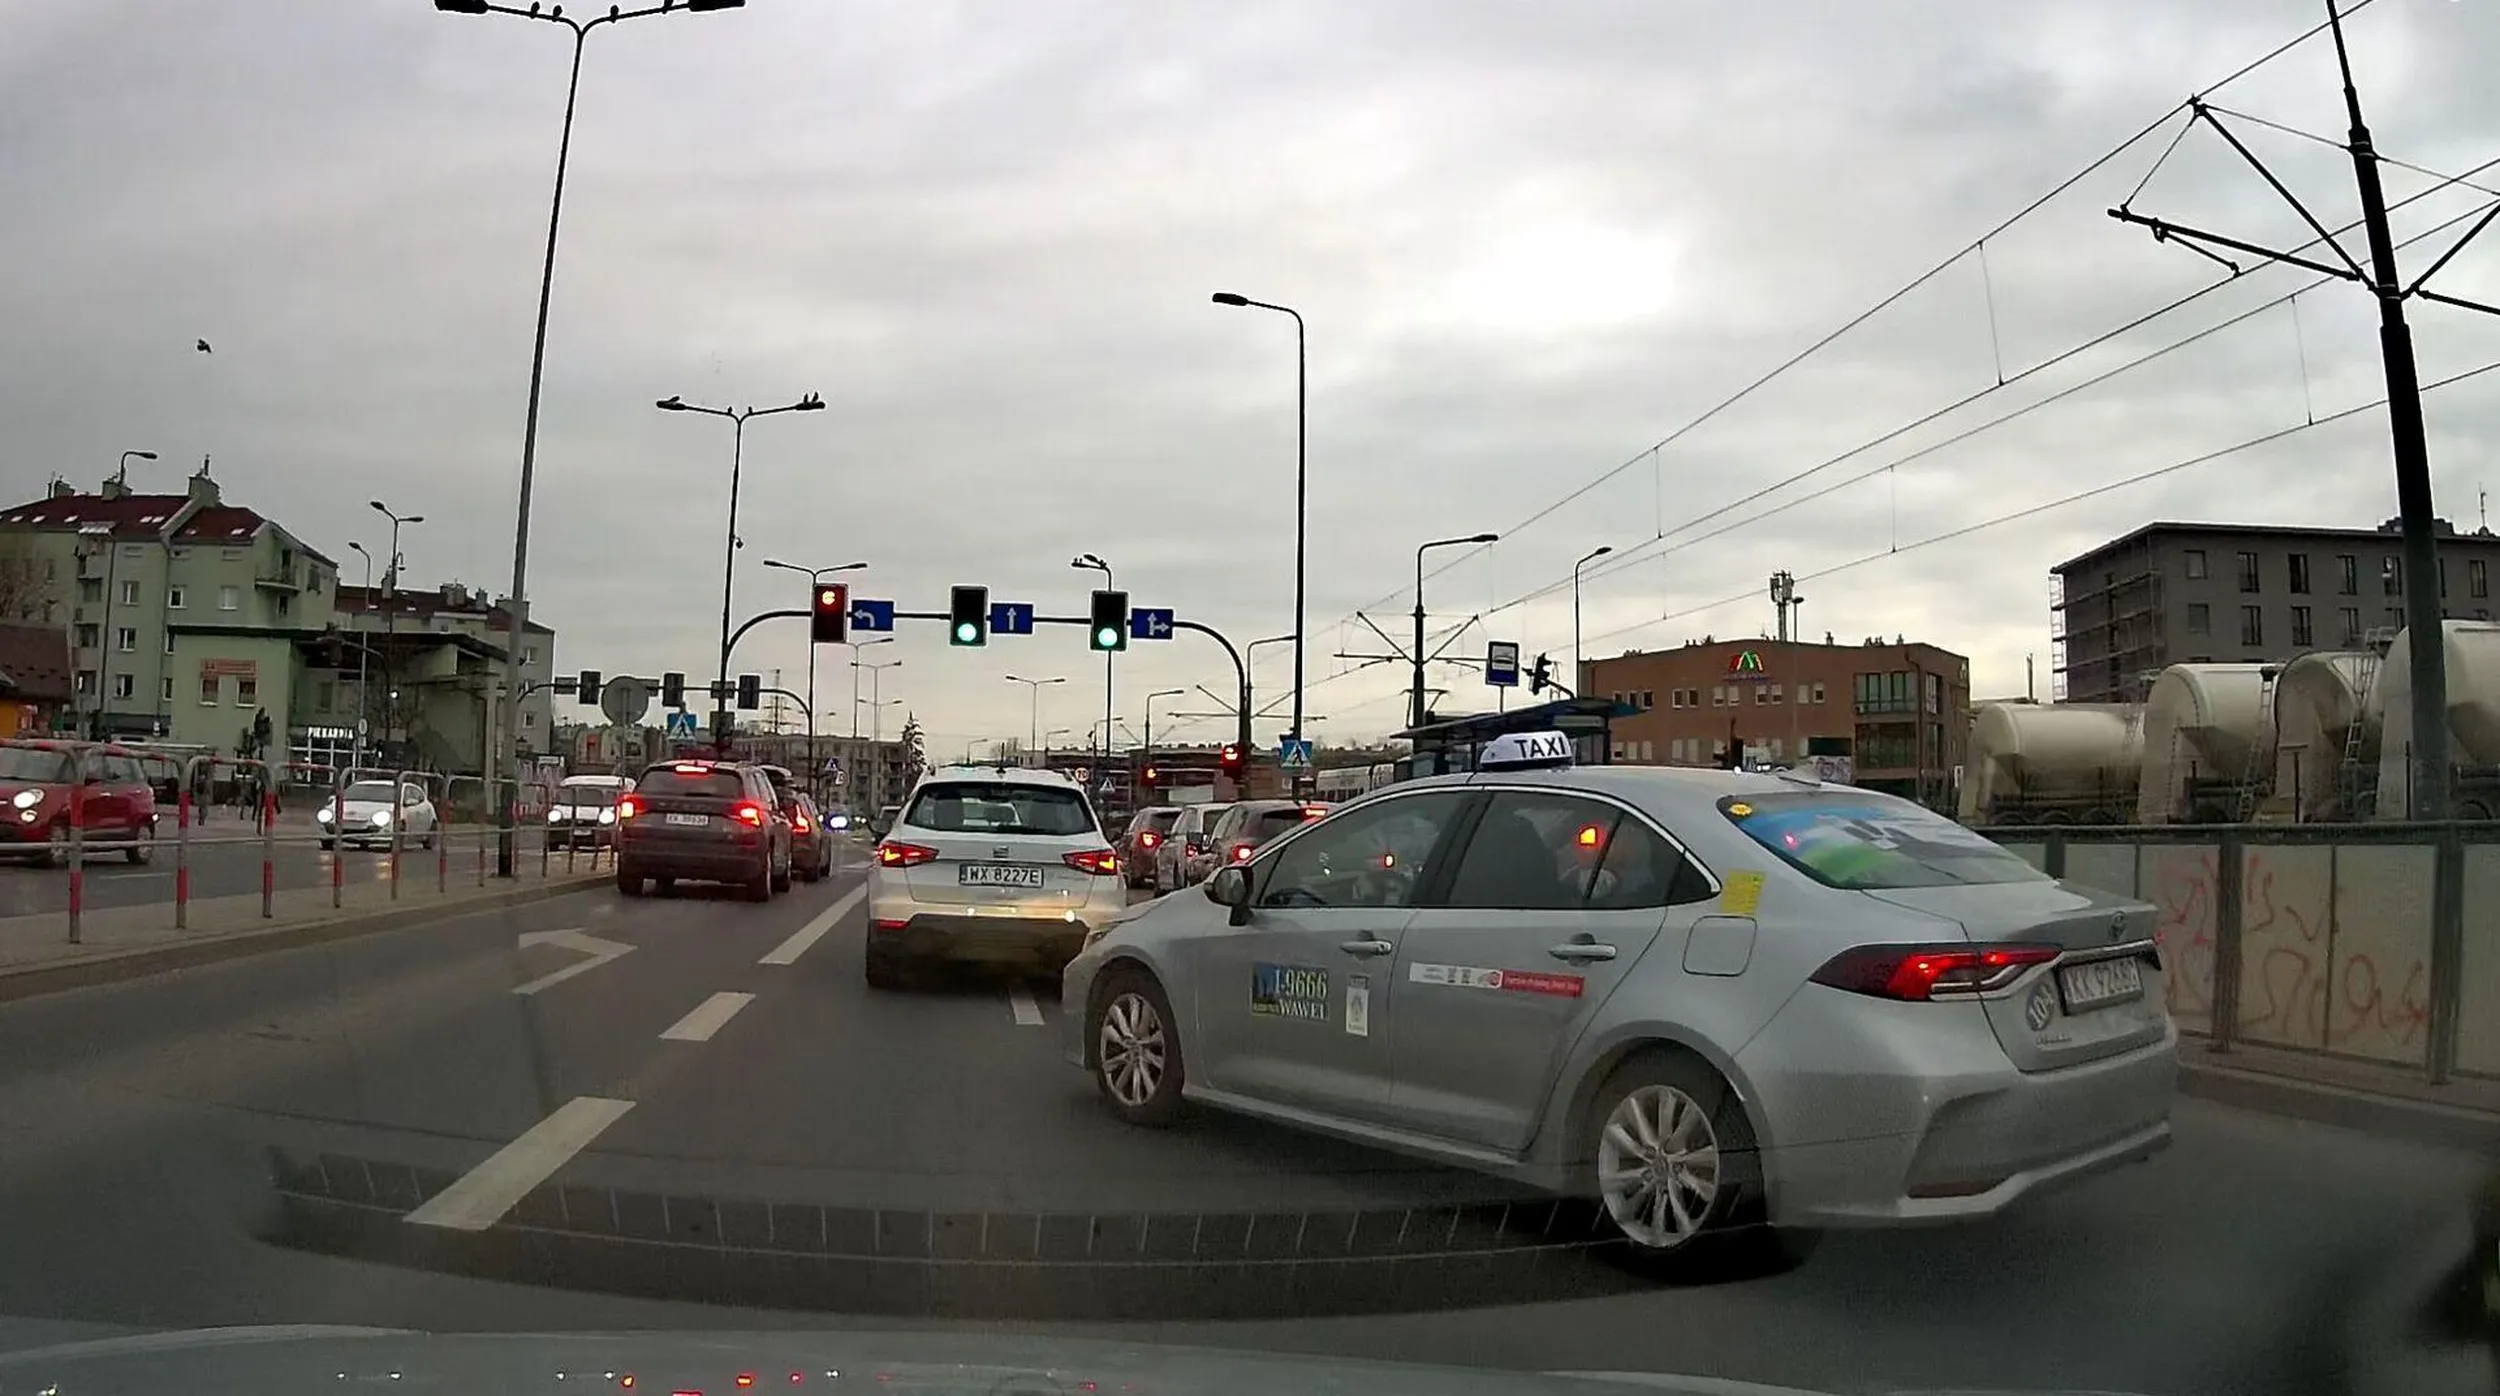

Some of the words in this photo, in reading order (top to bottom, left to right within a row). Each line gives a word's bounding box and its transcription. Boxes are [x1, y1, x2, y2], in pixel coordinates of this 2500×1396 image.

[1514, 736, 1567, 759] TAXI
[969, 867, 989, 881] WX
[994, 868, 1039, 884] 8227E
[1279, 998, 1326, 1020] WAWEL
